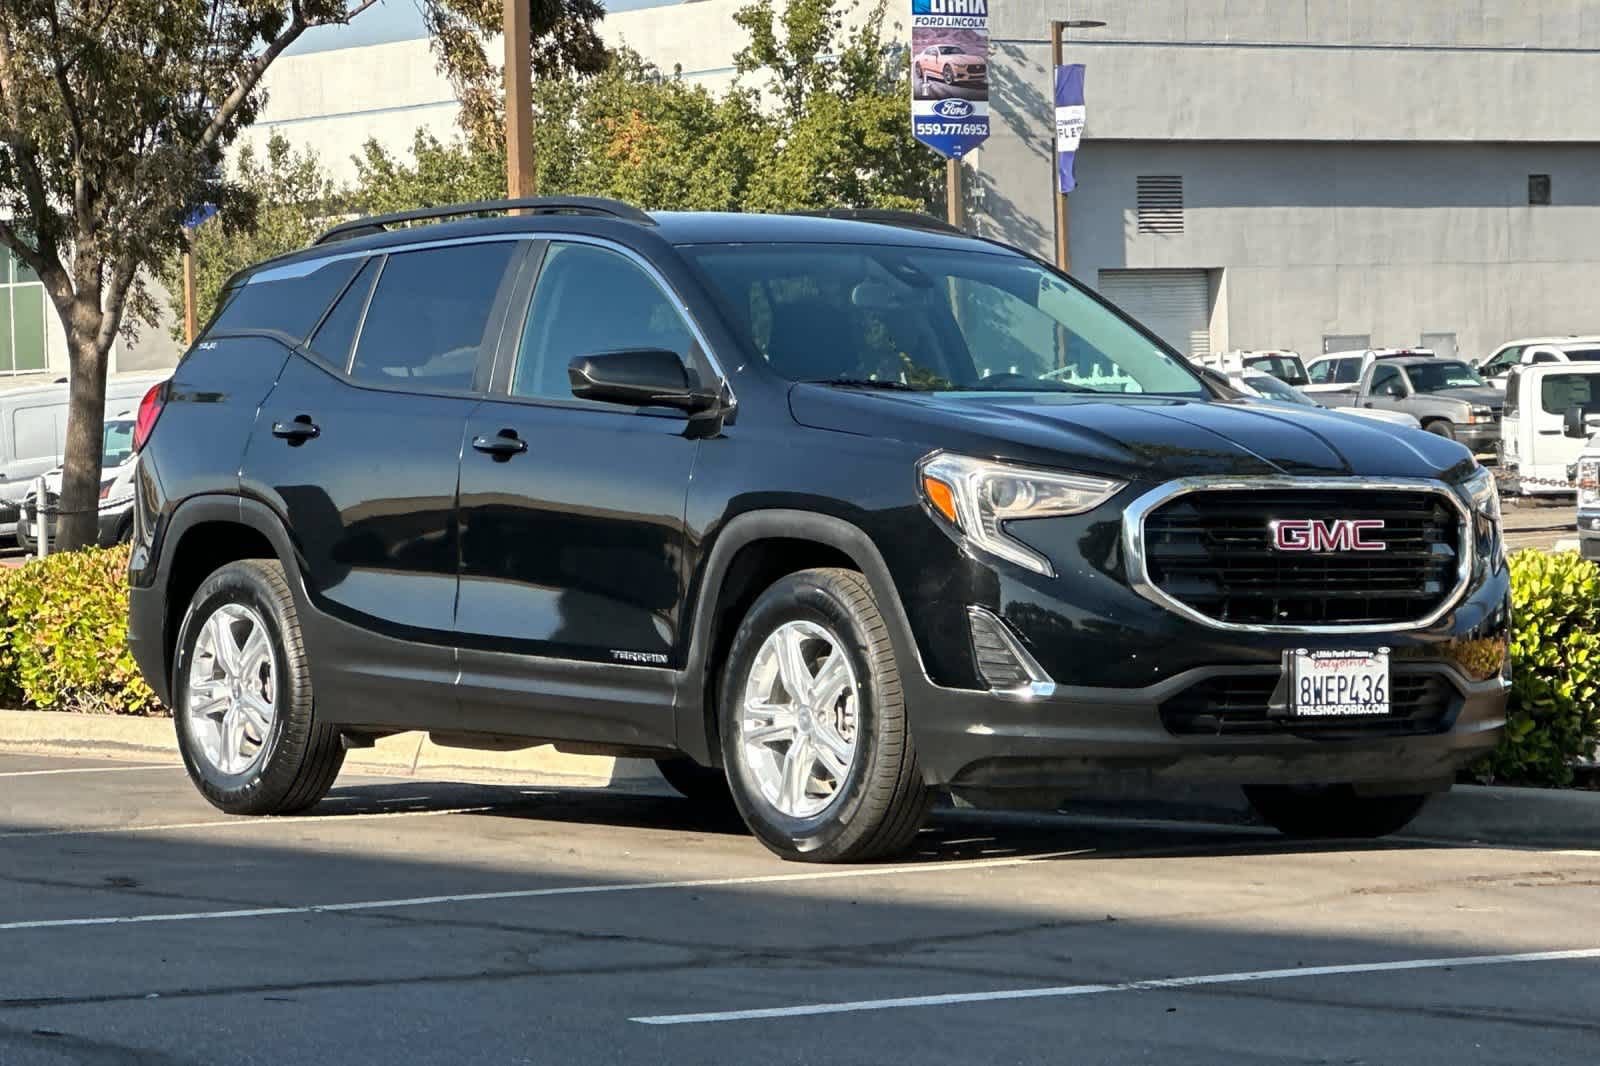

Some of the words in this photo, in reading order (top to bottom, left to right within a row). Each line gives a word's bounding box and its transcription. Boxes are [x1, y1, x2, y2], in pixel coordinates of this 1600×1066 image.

[915, 17, 944, 26] FORD
[946, 18, 986, 27] LINCOLN
[941, 101, 968, 115] Ford
[917, 123, 988, 135] 559.777.6952
[1276, 520, 1386, 550] GMC
[1301, 674, 1384, 705] 8WEP436
[1297, 703, 1389, 715] FRESNOFORD.COM
